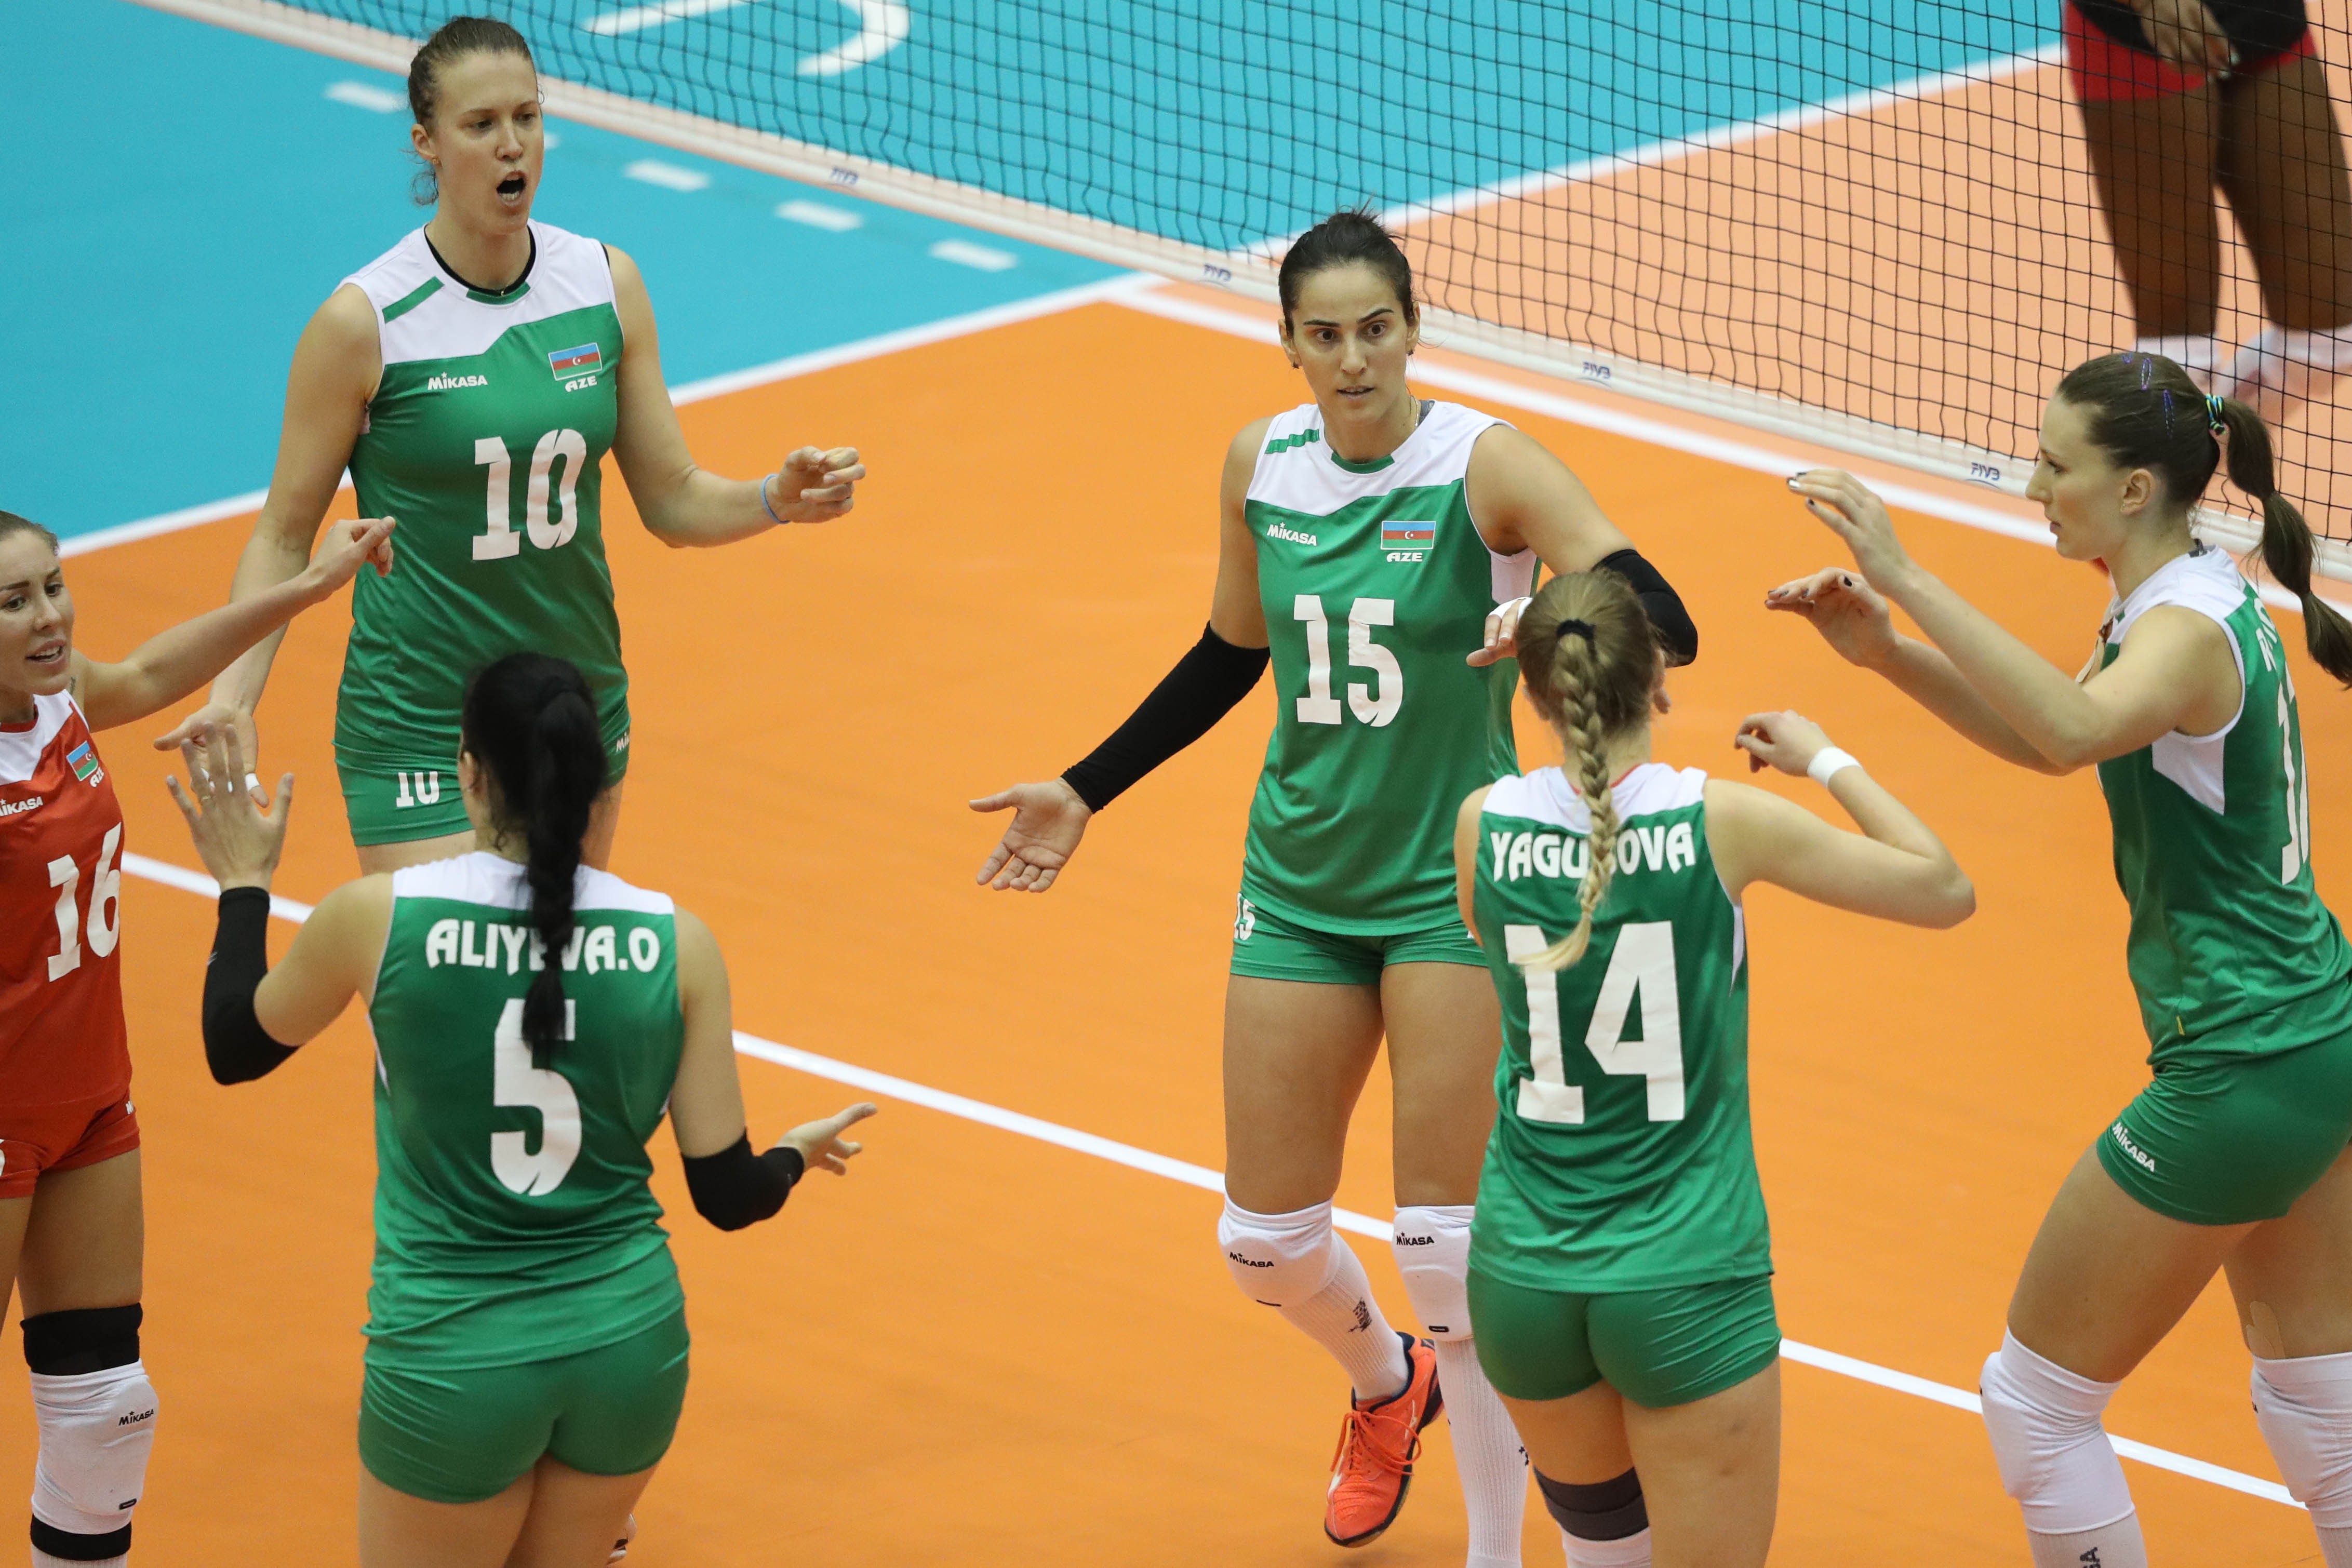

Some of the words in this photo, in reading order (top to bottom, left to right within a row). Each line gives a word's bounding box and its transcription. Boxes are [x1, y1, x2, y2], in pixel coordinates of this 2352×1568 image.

[565, 376, 597, 392] AZE
[472, 428, 586, 560] 10
[1386, 552, 1423, 562] AZE
[1293, 594, 1403, 727] 15
[2278, 661, 2308, 886] 1
[47, 822, 121, 982] 16
[1490, 822, 1695, 882] YAGUOVA
[1504, 920, 1686, 1124] 14
[490, 998, 582, 1196] 5
